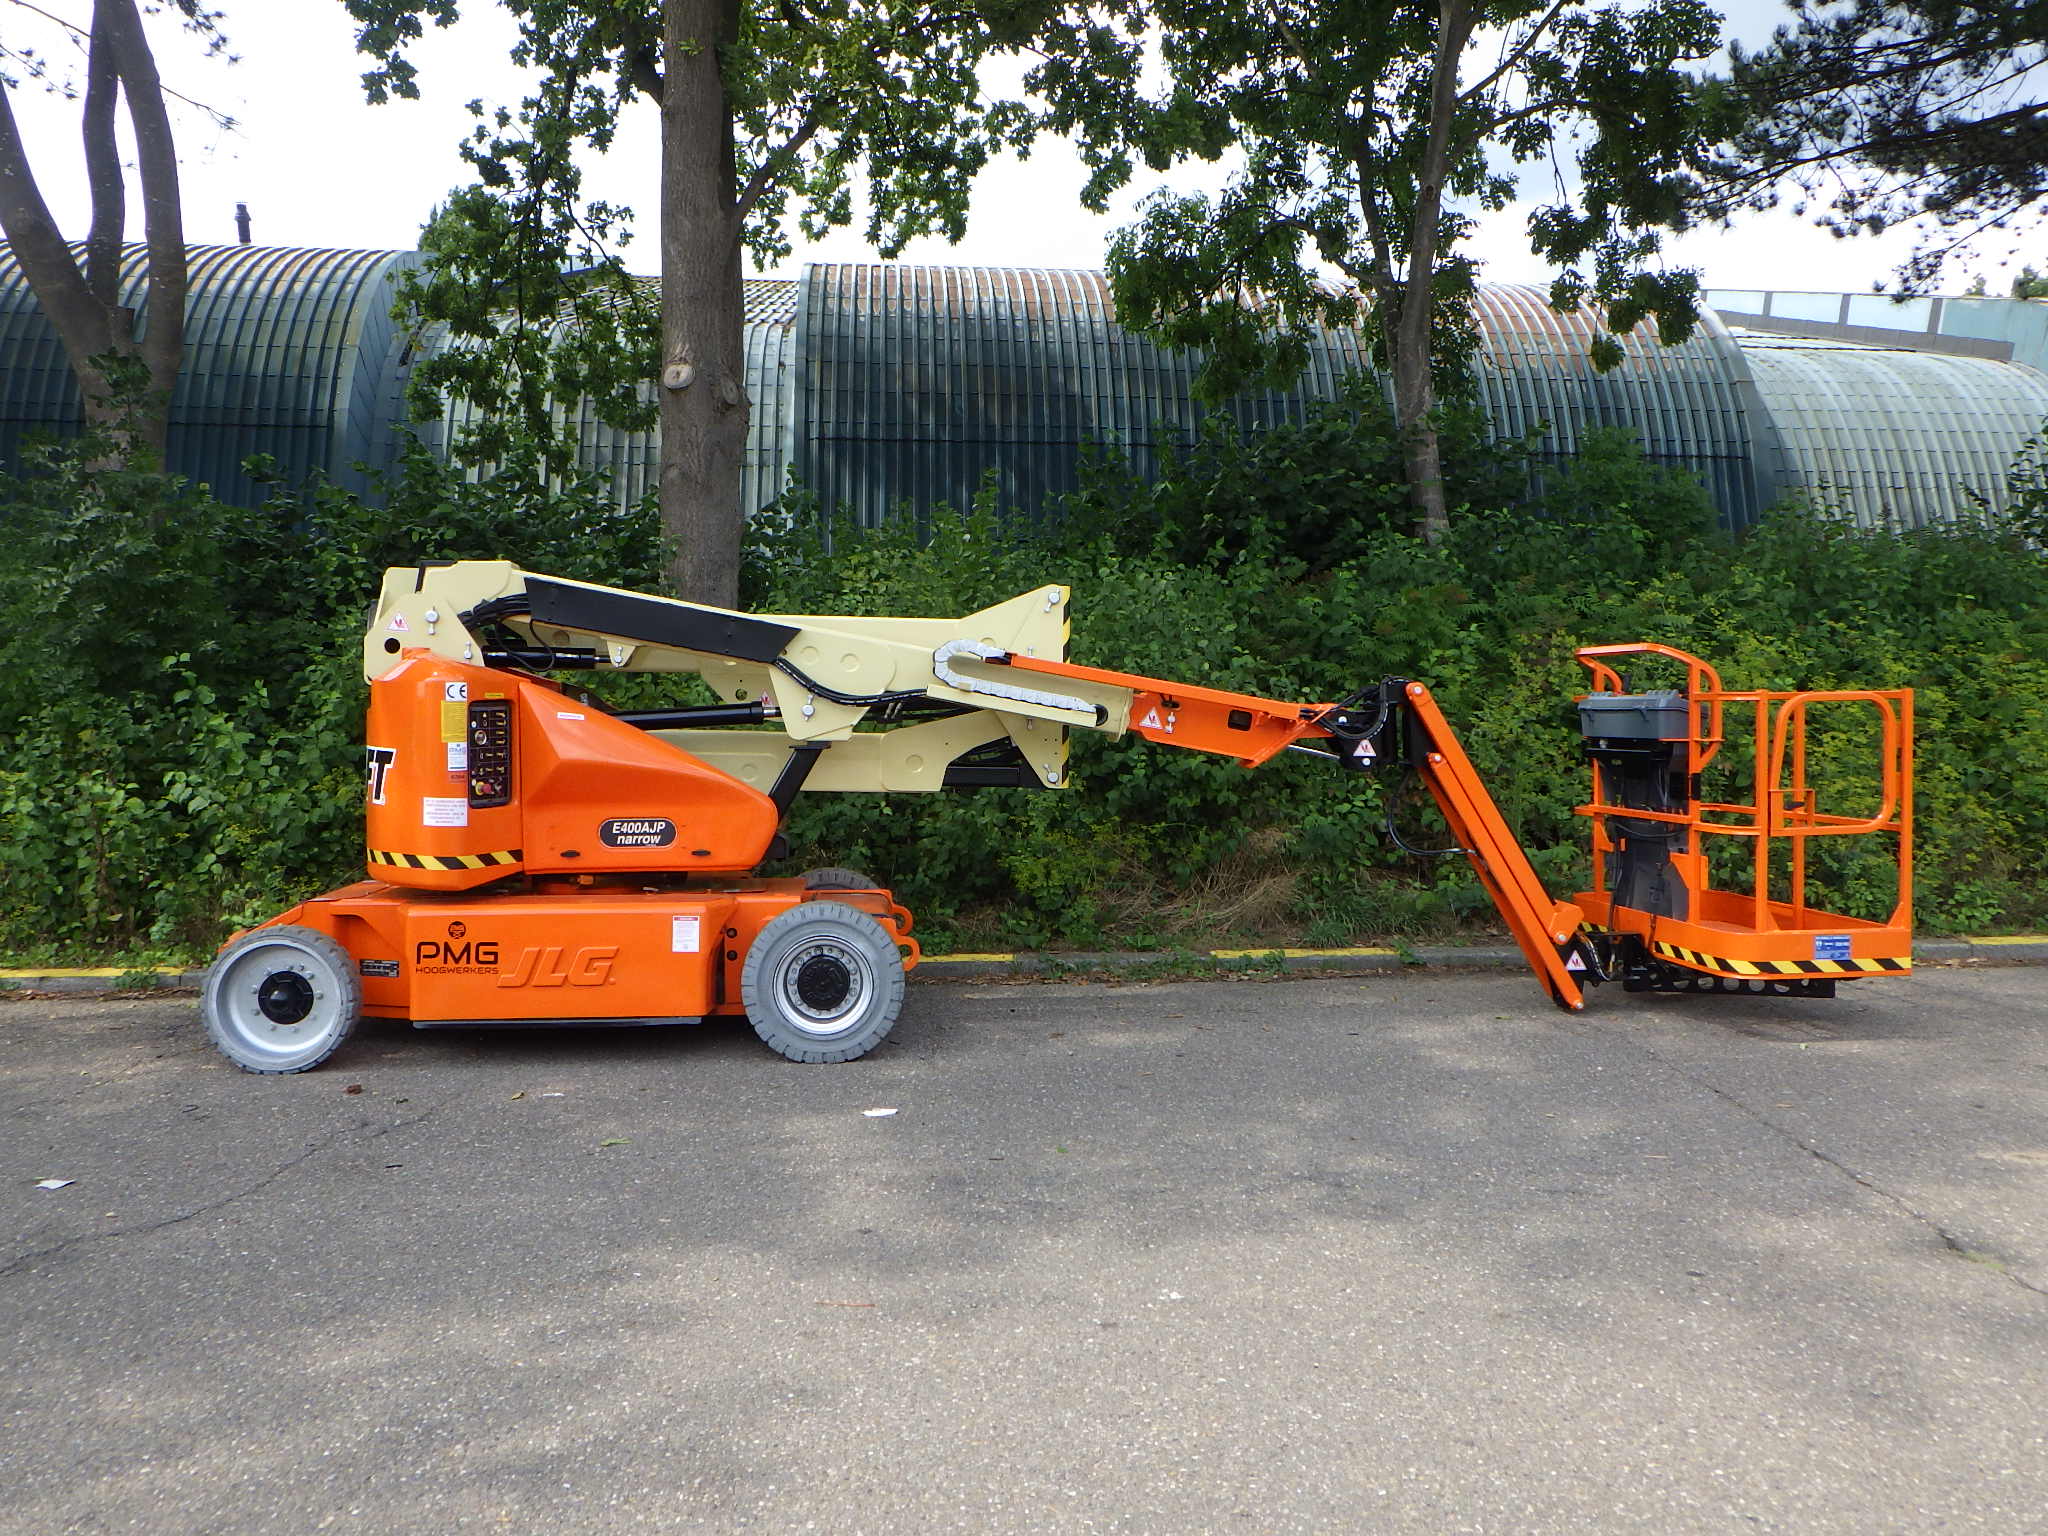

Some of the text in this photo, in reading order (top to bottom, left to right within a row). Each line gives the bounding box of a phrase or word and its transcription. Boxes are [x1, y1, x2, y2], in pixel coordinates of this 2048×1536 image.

[612, 821, 666, 834] E400AJP
[617, 834, 661, 845] narrow
[416, 941, 499, 965] PMG
[415, 966, 500, 975] HOOGWERKERS
[496, 946, 619, 989] JLG
